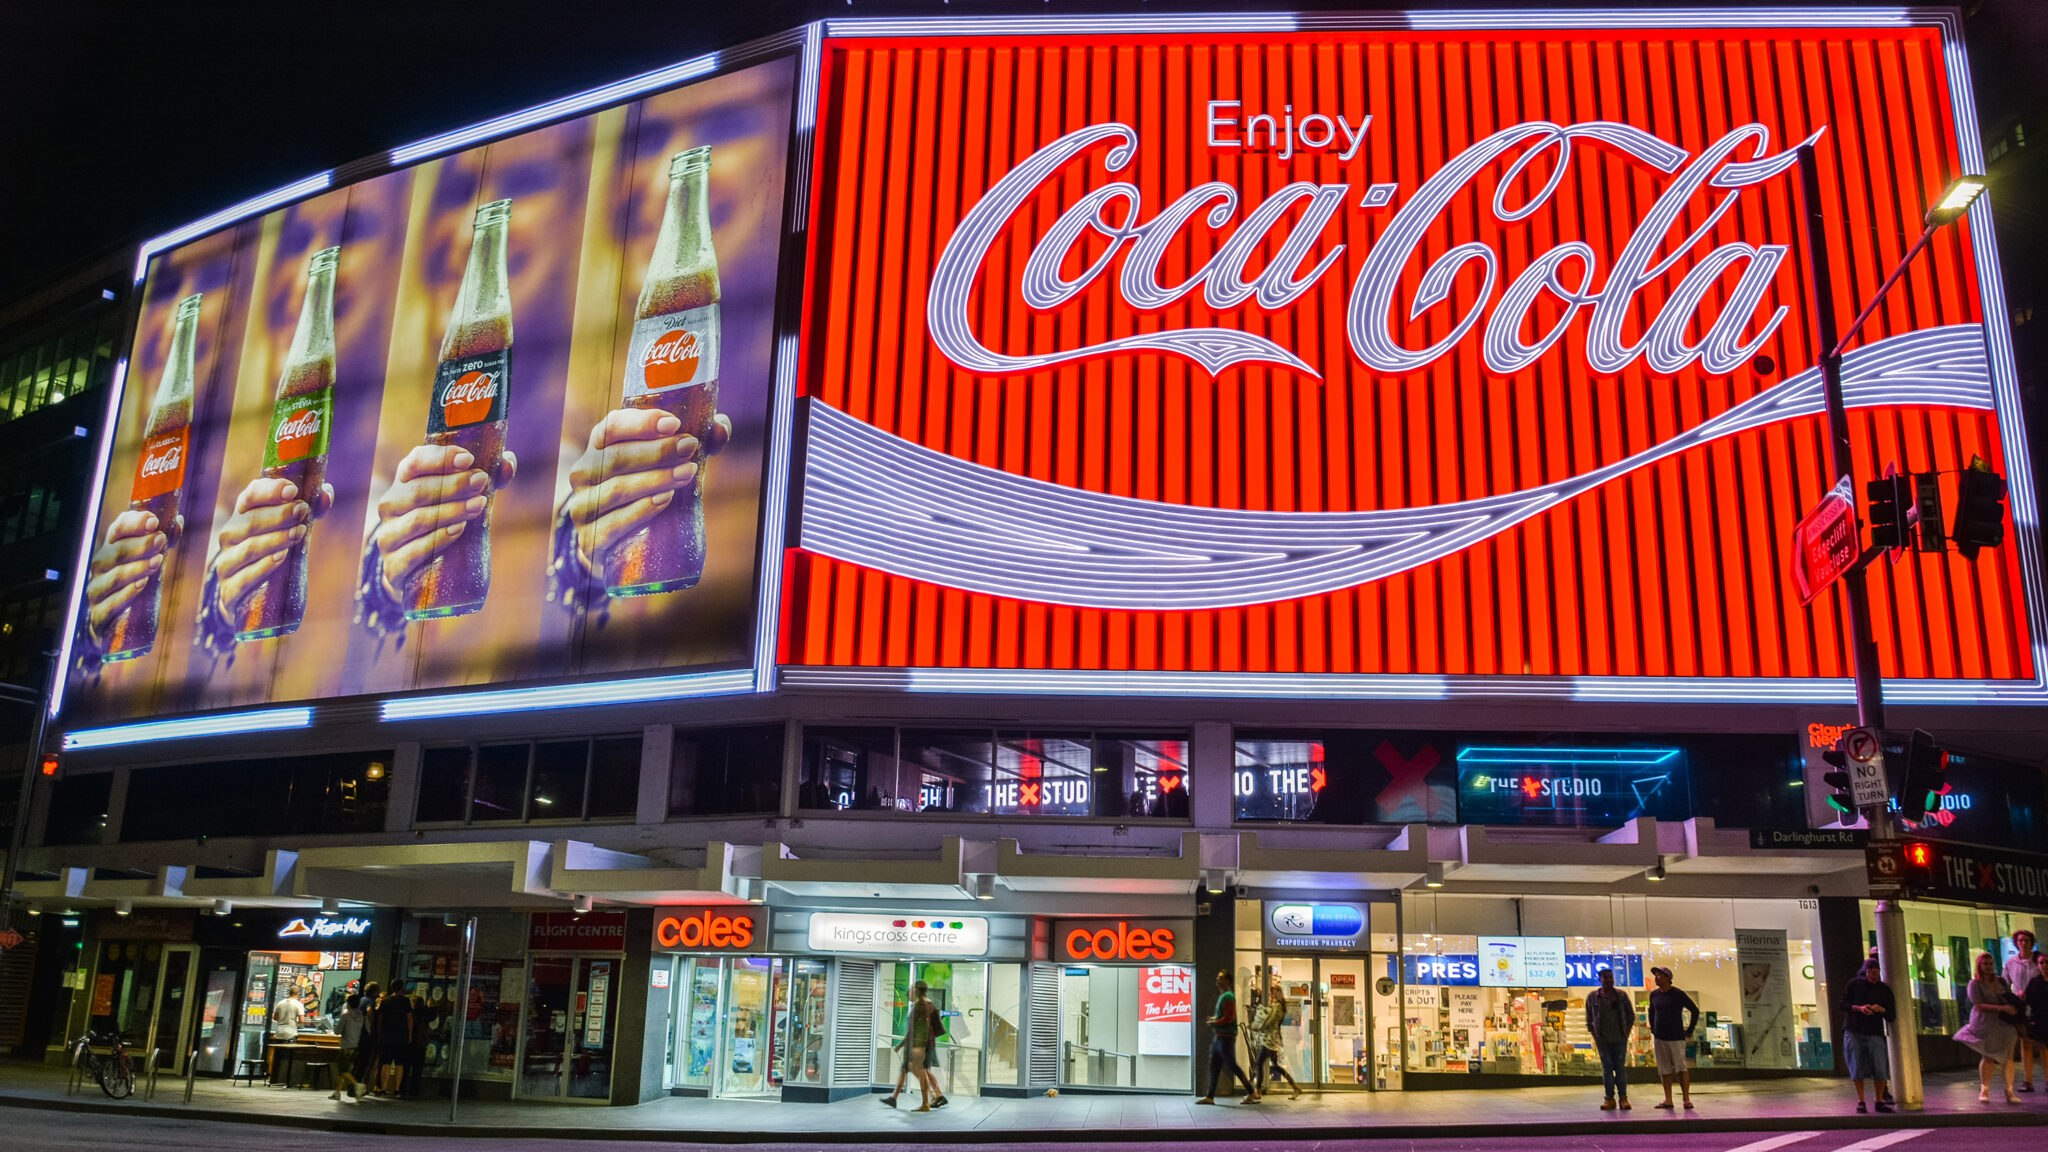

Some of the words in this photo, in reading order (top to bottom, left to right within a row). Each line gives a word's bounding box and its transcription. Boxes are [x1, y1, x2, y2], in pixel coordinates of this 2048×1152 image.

[1206, 100, 1374, 161] Enjoy
[927, 119, 1827, 379] Coca-Cola
[664, 316, 686, 330] Diet
[639, 328, 706, 368] Coca-Cola
[462, 360, 484, 372] zero
[440, 370, 502, 408] Coca-Cola
[291, 398, 312, 410] STEVIA
[275, 408, 324, 443] Coca-Cola
[141, 446, 183, 479] Coca-Cola
[1811, 518, 1847, 563] Edgecliff
[1813, 545, 1850, 584] Vaucluse
[1808, 723, 1858, 739] Clau
[1856, 764, 1877, 779] NO
[1269, 768, 1309, 794] THE
[1541, 777, 1602, 797] STUDIO
[1854, 778, 1883, 791] RIGHT
[985, 783, 1018, 807] THE
[1857, 790, 1885, 801] TURN
[1773, 831, 1837, 844] Darlinghurst
[1838, 832, 1854, 843] Rd
[1943, 855, 1976, 890] THE
[1799, 900, 1818, 910] TG13
[310, 918, 344, 937] Pizza
[343, 917, 372, 935] Hut
[534, 925, 576, 937] FLIGHT
[576, 925, 625, 937] CENTRE
[656, 909, 753, 948] coles
[833, 926, 872, 944] kings
[873, 930, 908, 943] cross
[910, 931, 957, 944] centre
[1065, 921, 1175, 960] coles
[1321, 938, 1358, 948] PHARMACY
[1737, 934, 1781, 946] Fillerina
[1416, 961, 1477, 979] PRES
[1528, 969, 1557, 978] $32.49
[1332, 975, 1354, 985] OPEN
[1405, 988, 1431, 996] CRIPTS
[1454, 993, 1478, 1001] PLEASE
[1144, 1002, 1161, 1016] The
